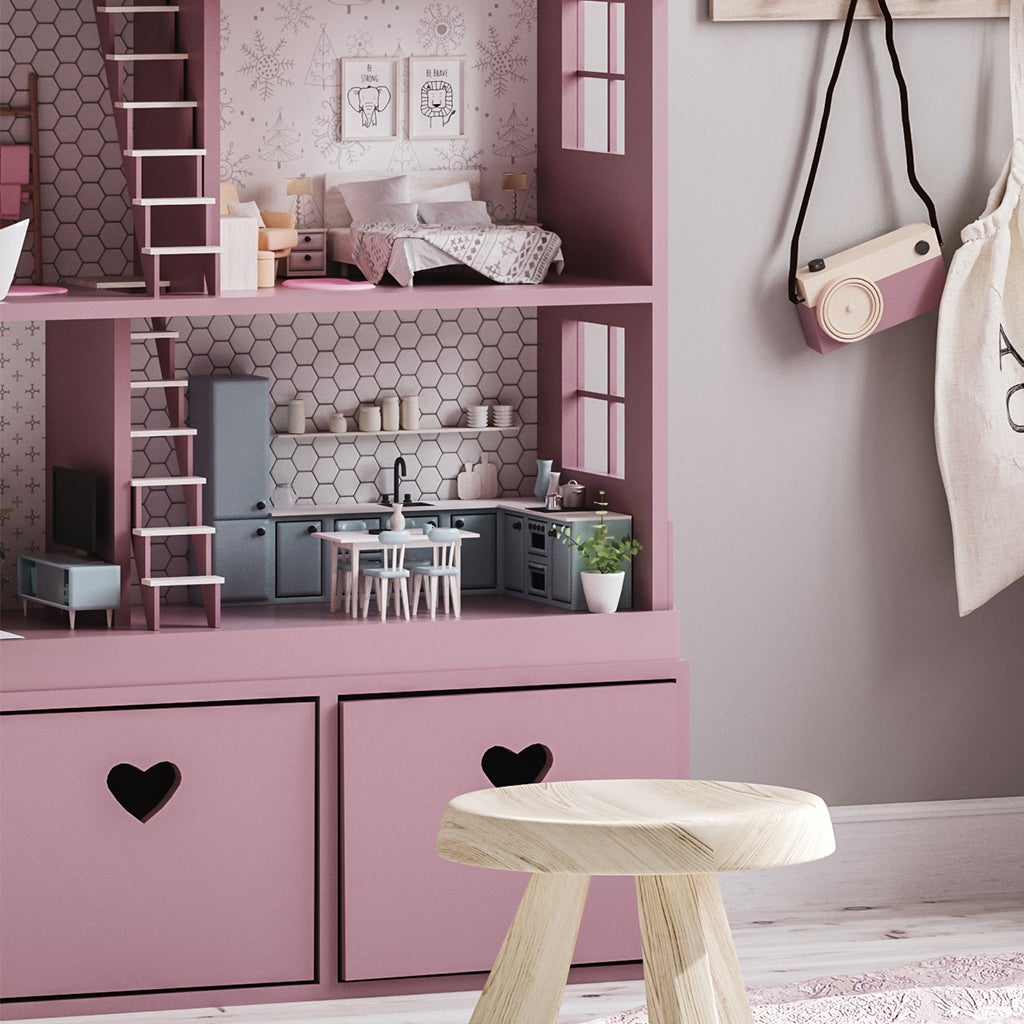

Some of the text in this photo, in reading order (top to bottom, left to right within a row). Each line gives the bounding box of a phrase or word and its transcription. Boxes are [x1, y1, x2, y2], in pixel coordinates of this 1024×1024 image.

[367, 64, 372, 72] BE
[426, 69, 448, 77] BE BRAVE
[361, 74, 379, 82] STRONG
